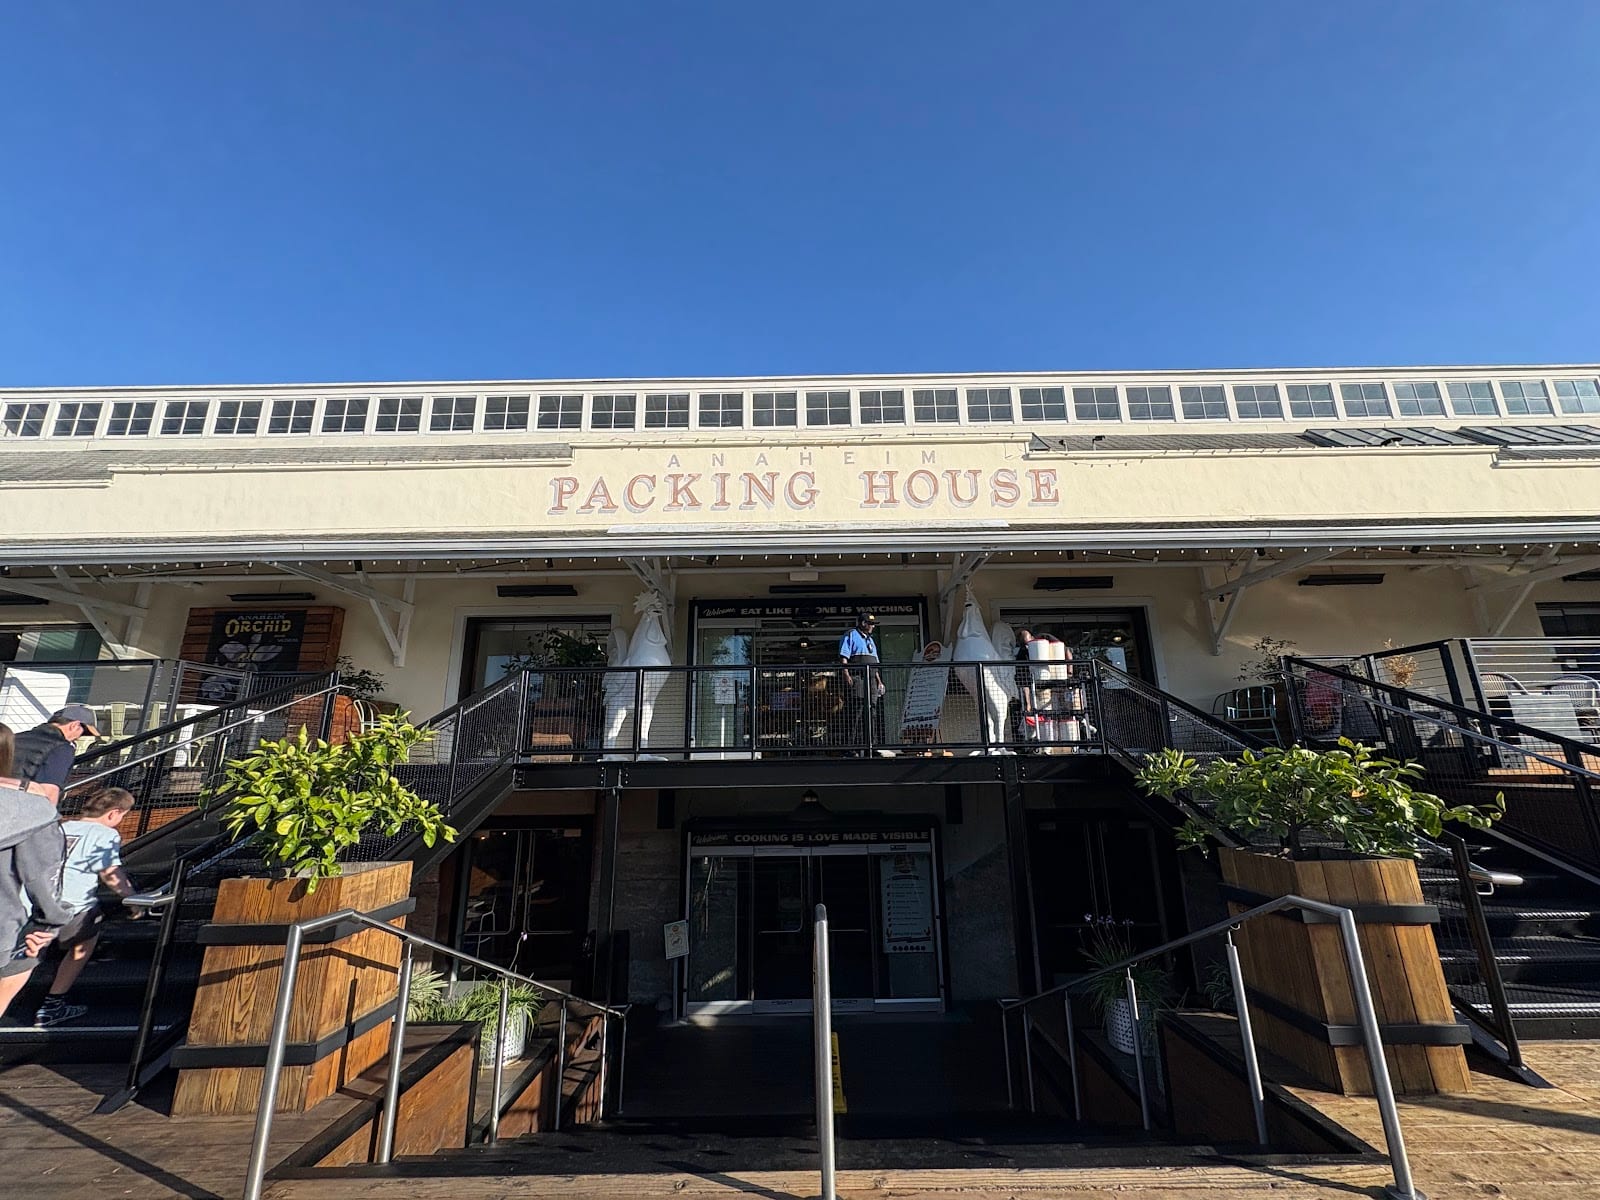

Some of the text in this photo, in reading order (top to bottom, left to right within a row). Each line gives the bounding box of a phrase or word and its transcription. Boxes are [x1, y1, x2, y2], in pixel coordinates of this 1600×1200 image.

[668, 450, 936, 468] ANAHEIM
[547, 468, 1060, 515] PACKING HOUSE
[740, 607, 763, 615] EAT
[765, 607, 793, 615] LIKE
[855, 605, 914, 613] WATCHING
[224, 618, 293, 638] ORCHID
[734, 834, 789, 843] COOKING
[791, 833, 805, 842] IS
[808, 833, 840, 841] LOVE
[842, 832, 879, 841] MADE
[881, 831, 929, 840] VISIBLE
